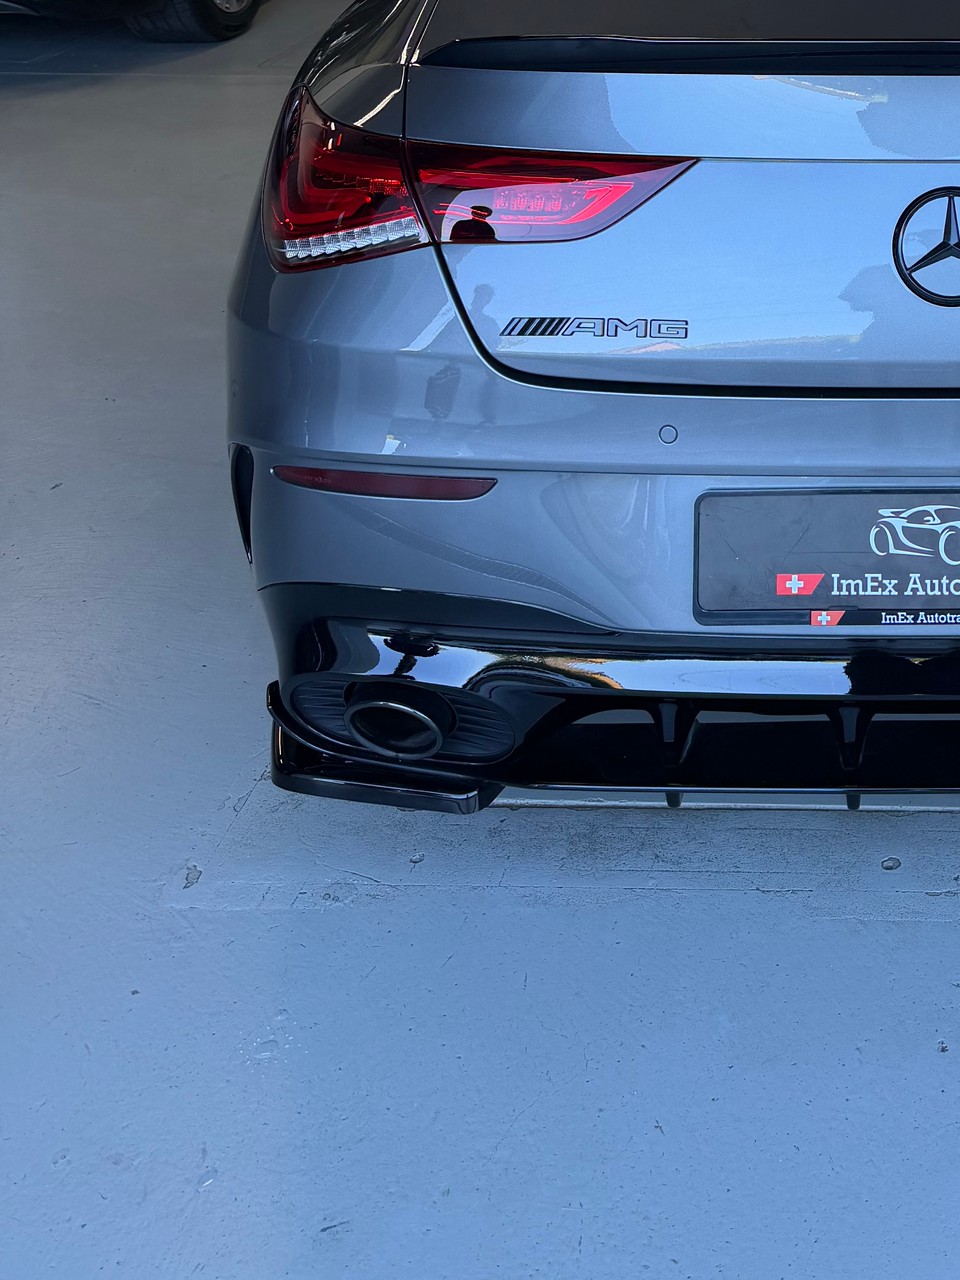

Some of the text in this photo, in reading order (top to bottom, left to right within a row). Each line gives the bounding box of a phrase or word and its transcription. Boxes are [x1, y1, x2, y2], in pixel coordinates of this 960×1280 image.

[561, 317, 689, 339] AMG
[831, 573, 898, 596] ImEx
[881, 612, 914, 624] ImEx
